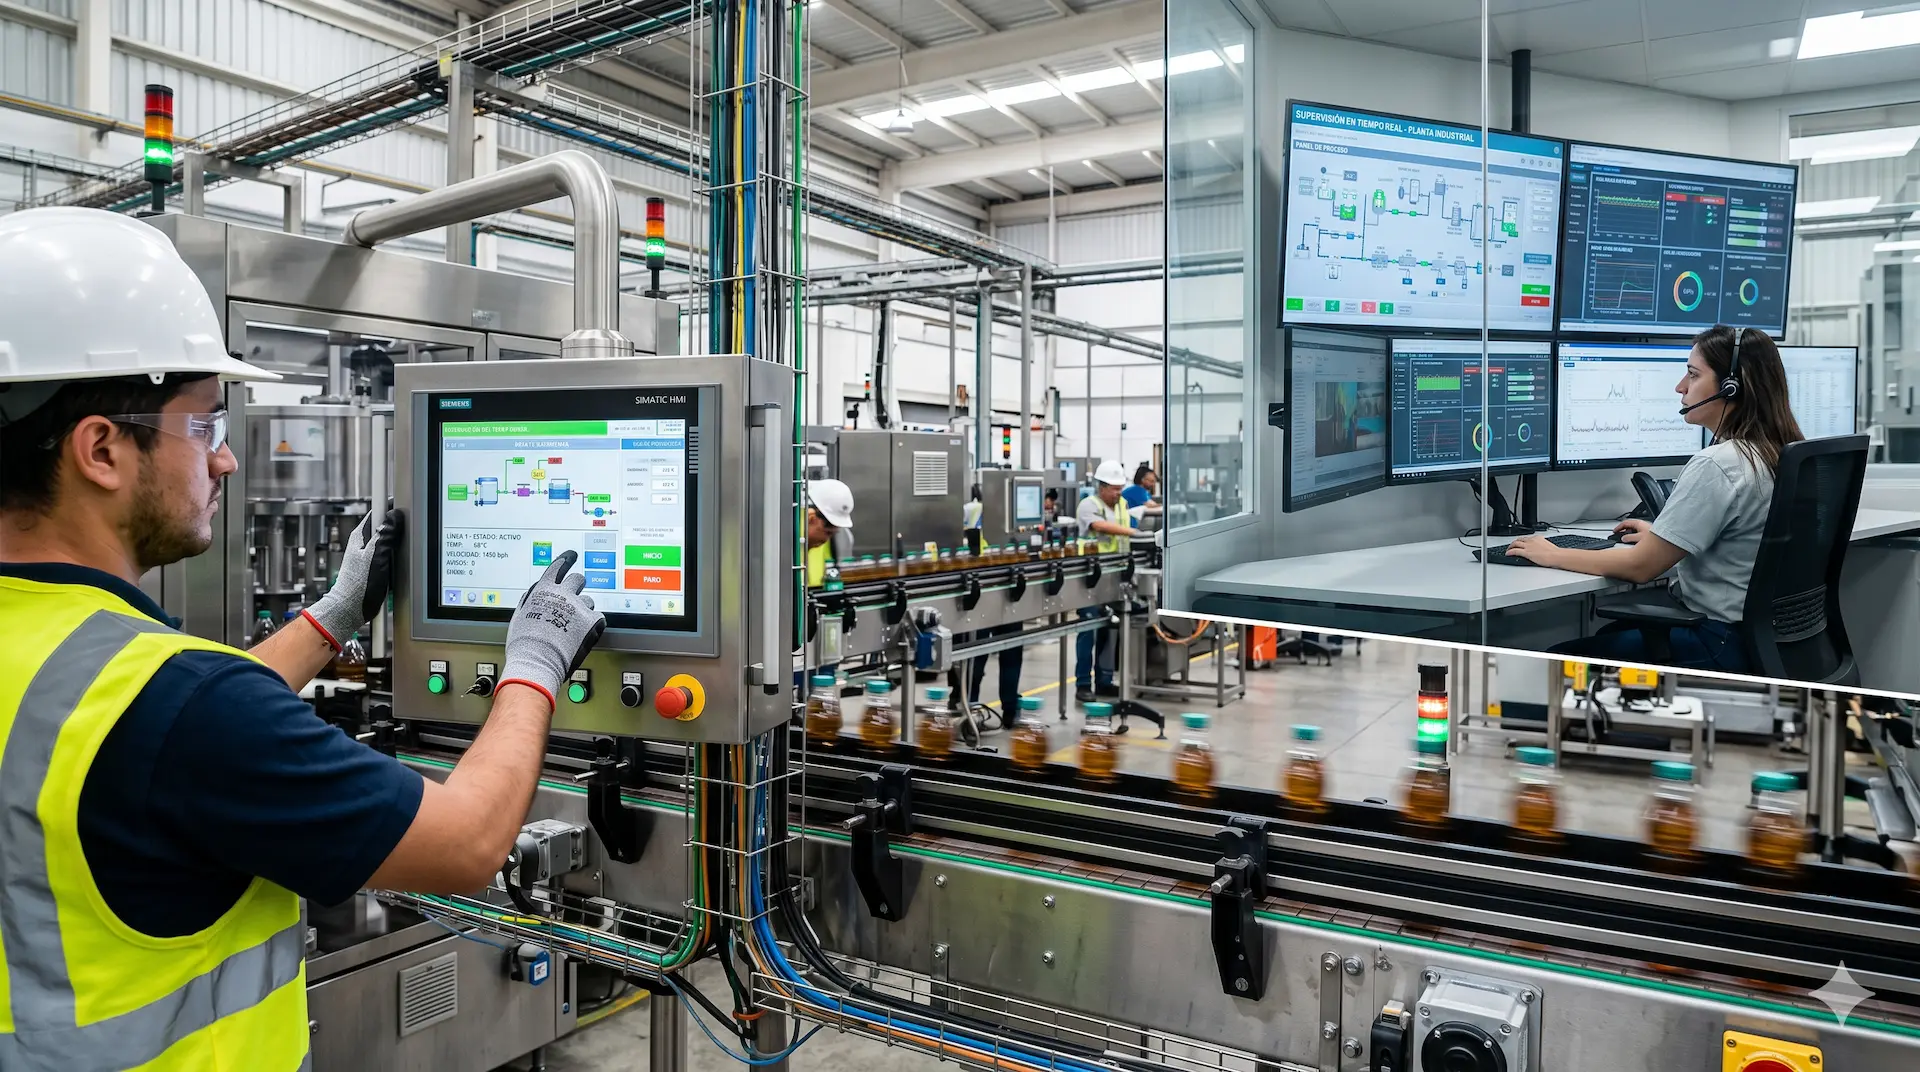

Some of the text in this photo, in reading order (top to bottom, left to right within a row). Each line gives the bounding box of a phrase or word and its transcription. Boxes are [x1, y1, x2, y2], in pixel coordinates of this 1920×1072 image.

[1295, 109, 1346, 125] SUPERVISIÓN
[1346, 117, 1356, 125] EN
[1357, 118, 1385, 131] TIEMPO
[1385, 122, 1403, 133] REAL
[1408, 125, 1434, 137] PLANTA
[1434, 129, 1475, 143] INDUSTRIAL
[1295, 141, 1349, 154] PANEL DE PROCESO
[441, 400, 470, 408] SIEMENS
[635, 395, 687, 405] SIMATIC HMI
[473, 533, 498, 541] ESTADO:
[497, 552, 509, 560] bph
[643, 576, 662, 584] PARO
